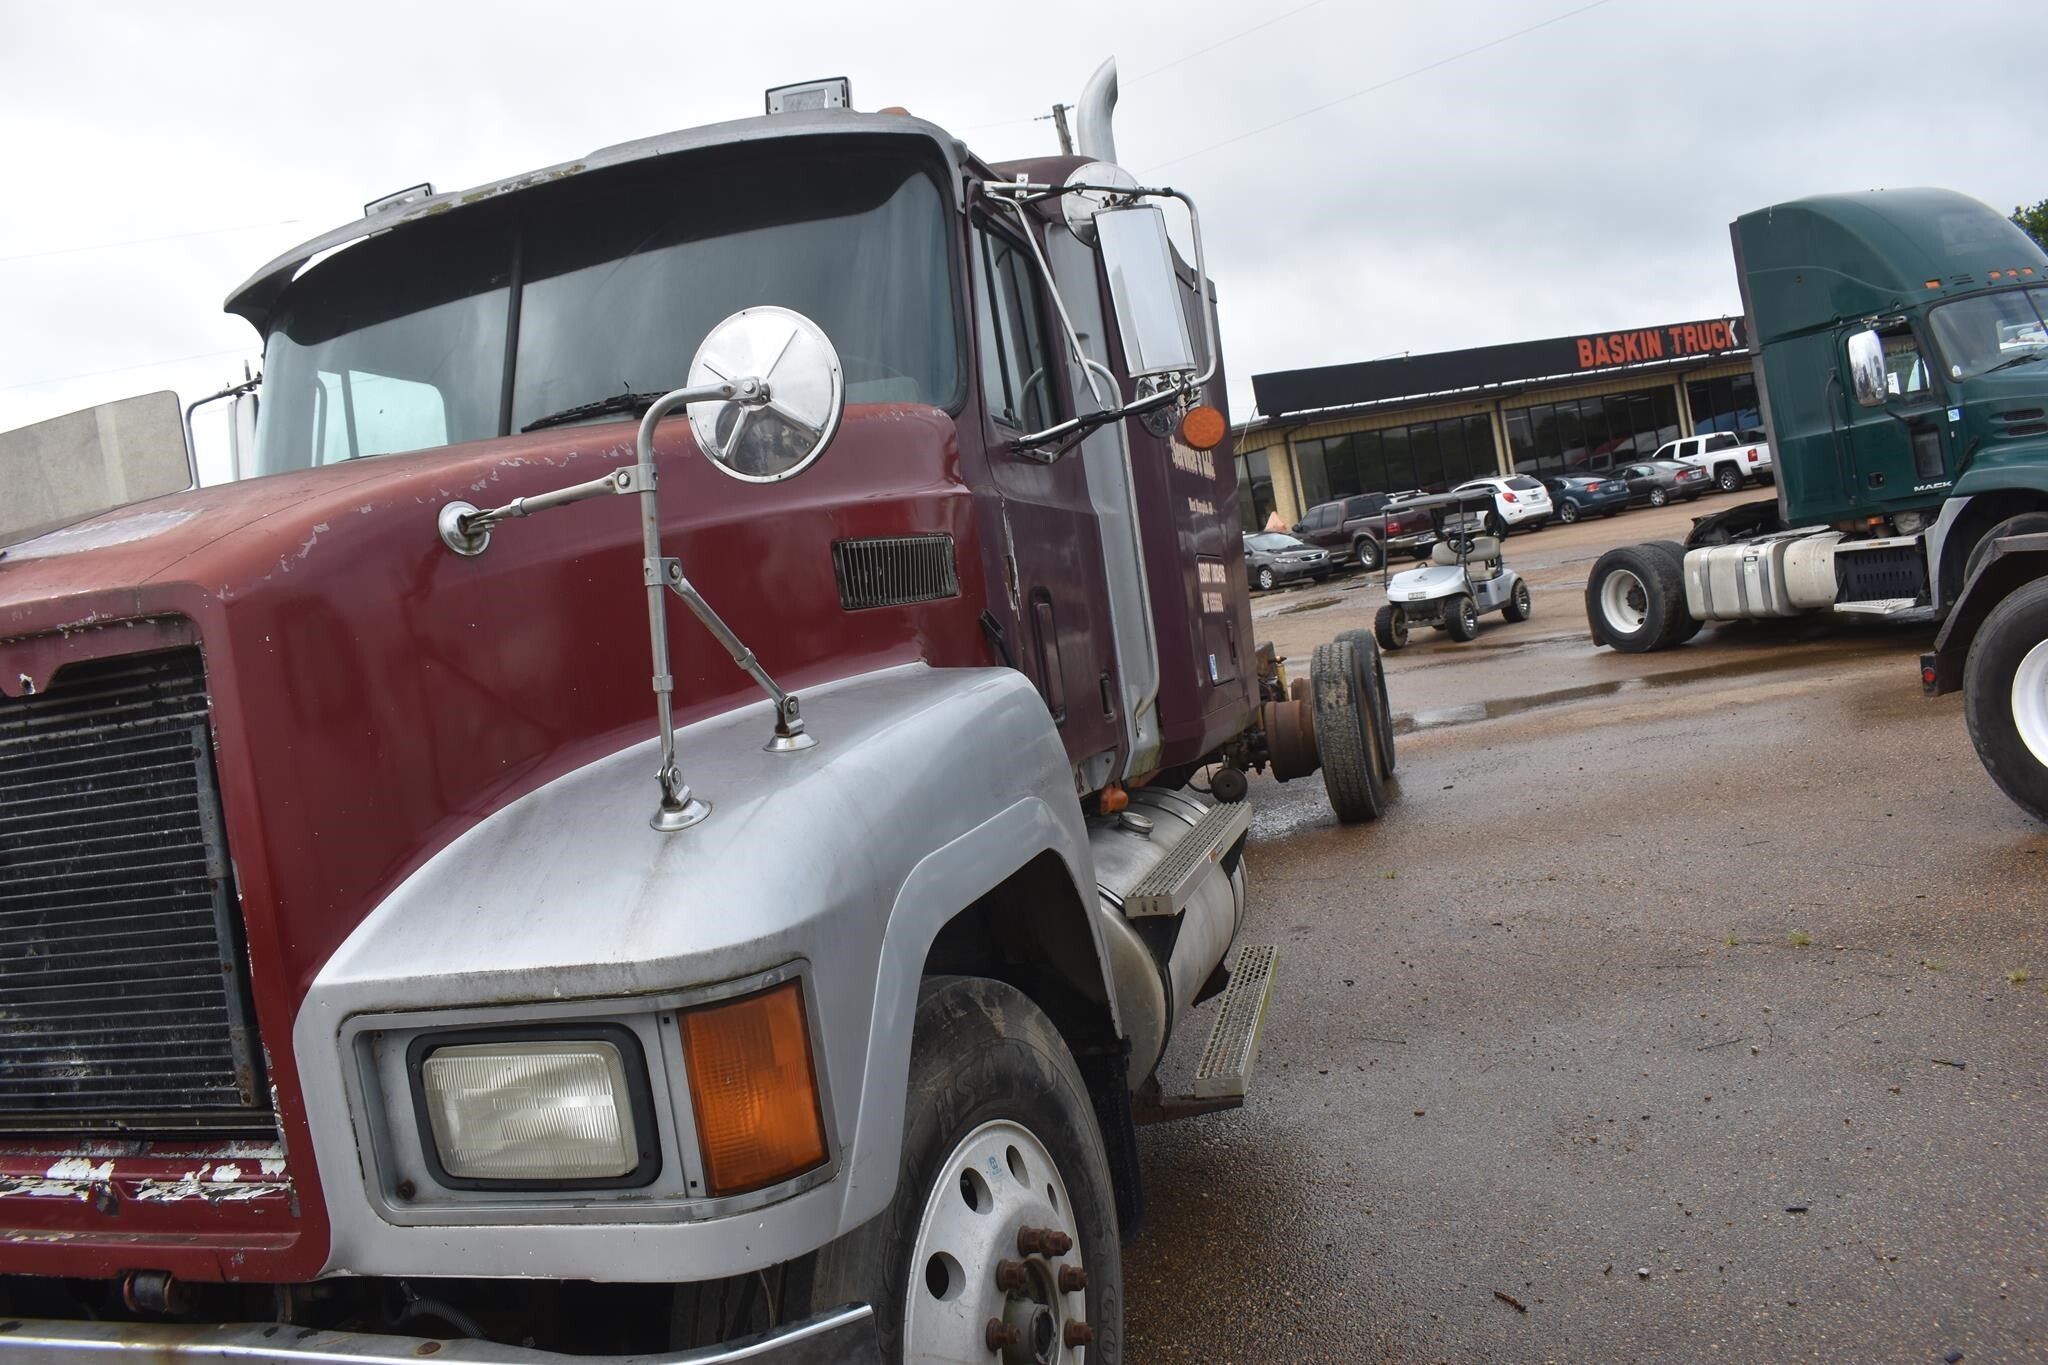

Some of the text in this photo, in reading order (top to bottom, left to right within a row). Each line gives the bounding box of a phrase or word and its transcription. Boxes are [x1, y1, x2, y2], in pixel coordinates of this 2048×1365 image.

[1576, 329, 1663, 368] BASKIN
[1669, 320, 1739, 355] TRUCK
[1913, 480, 1952, 492] MACK
